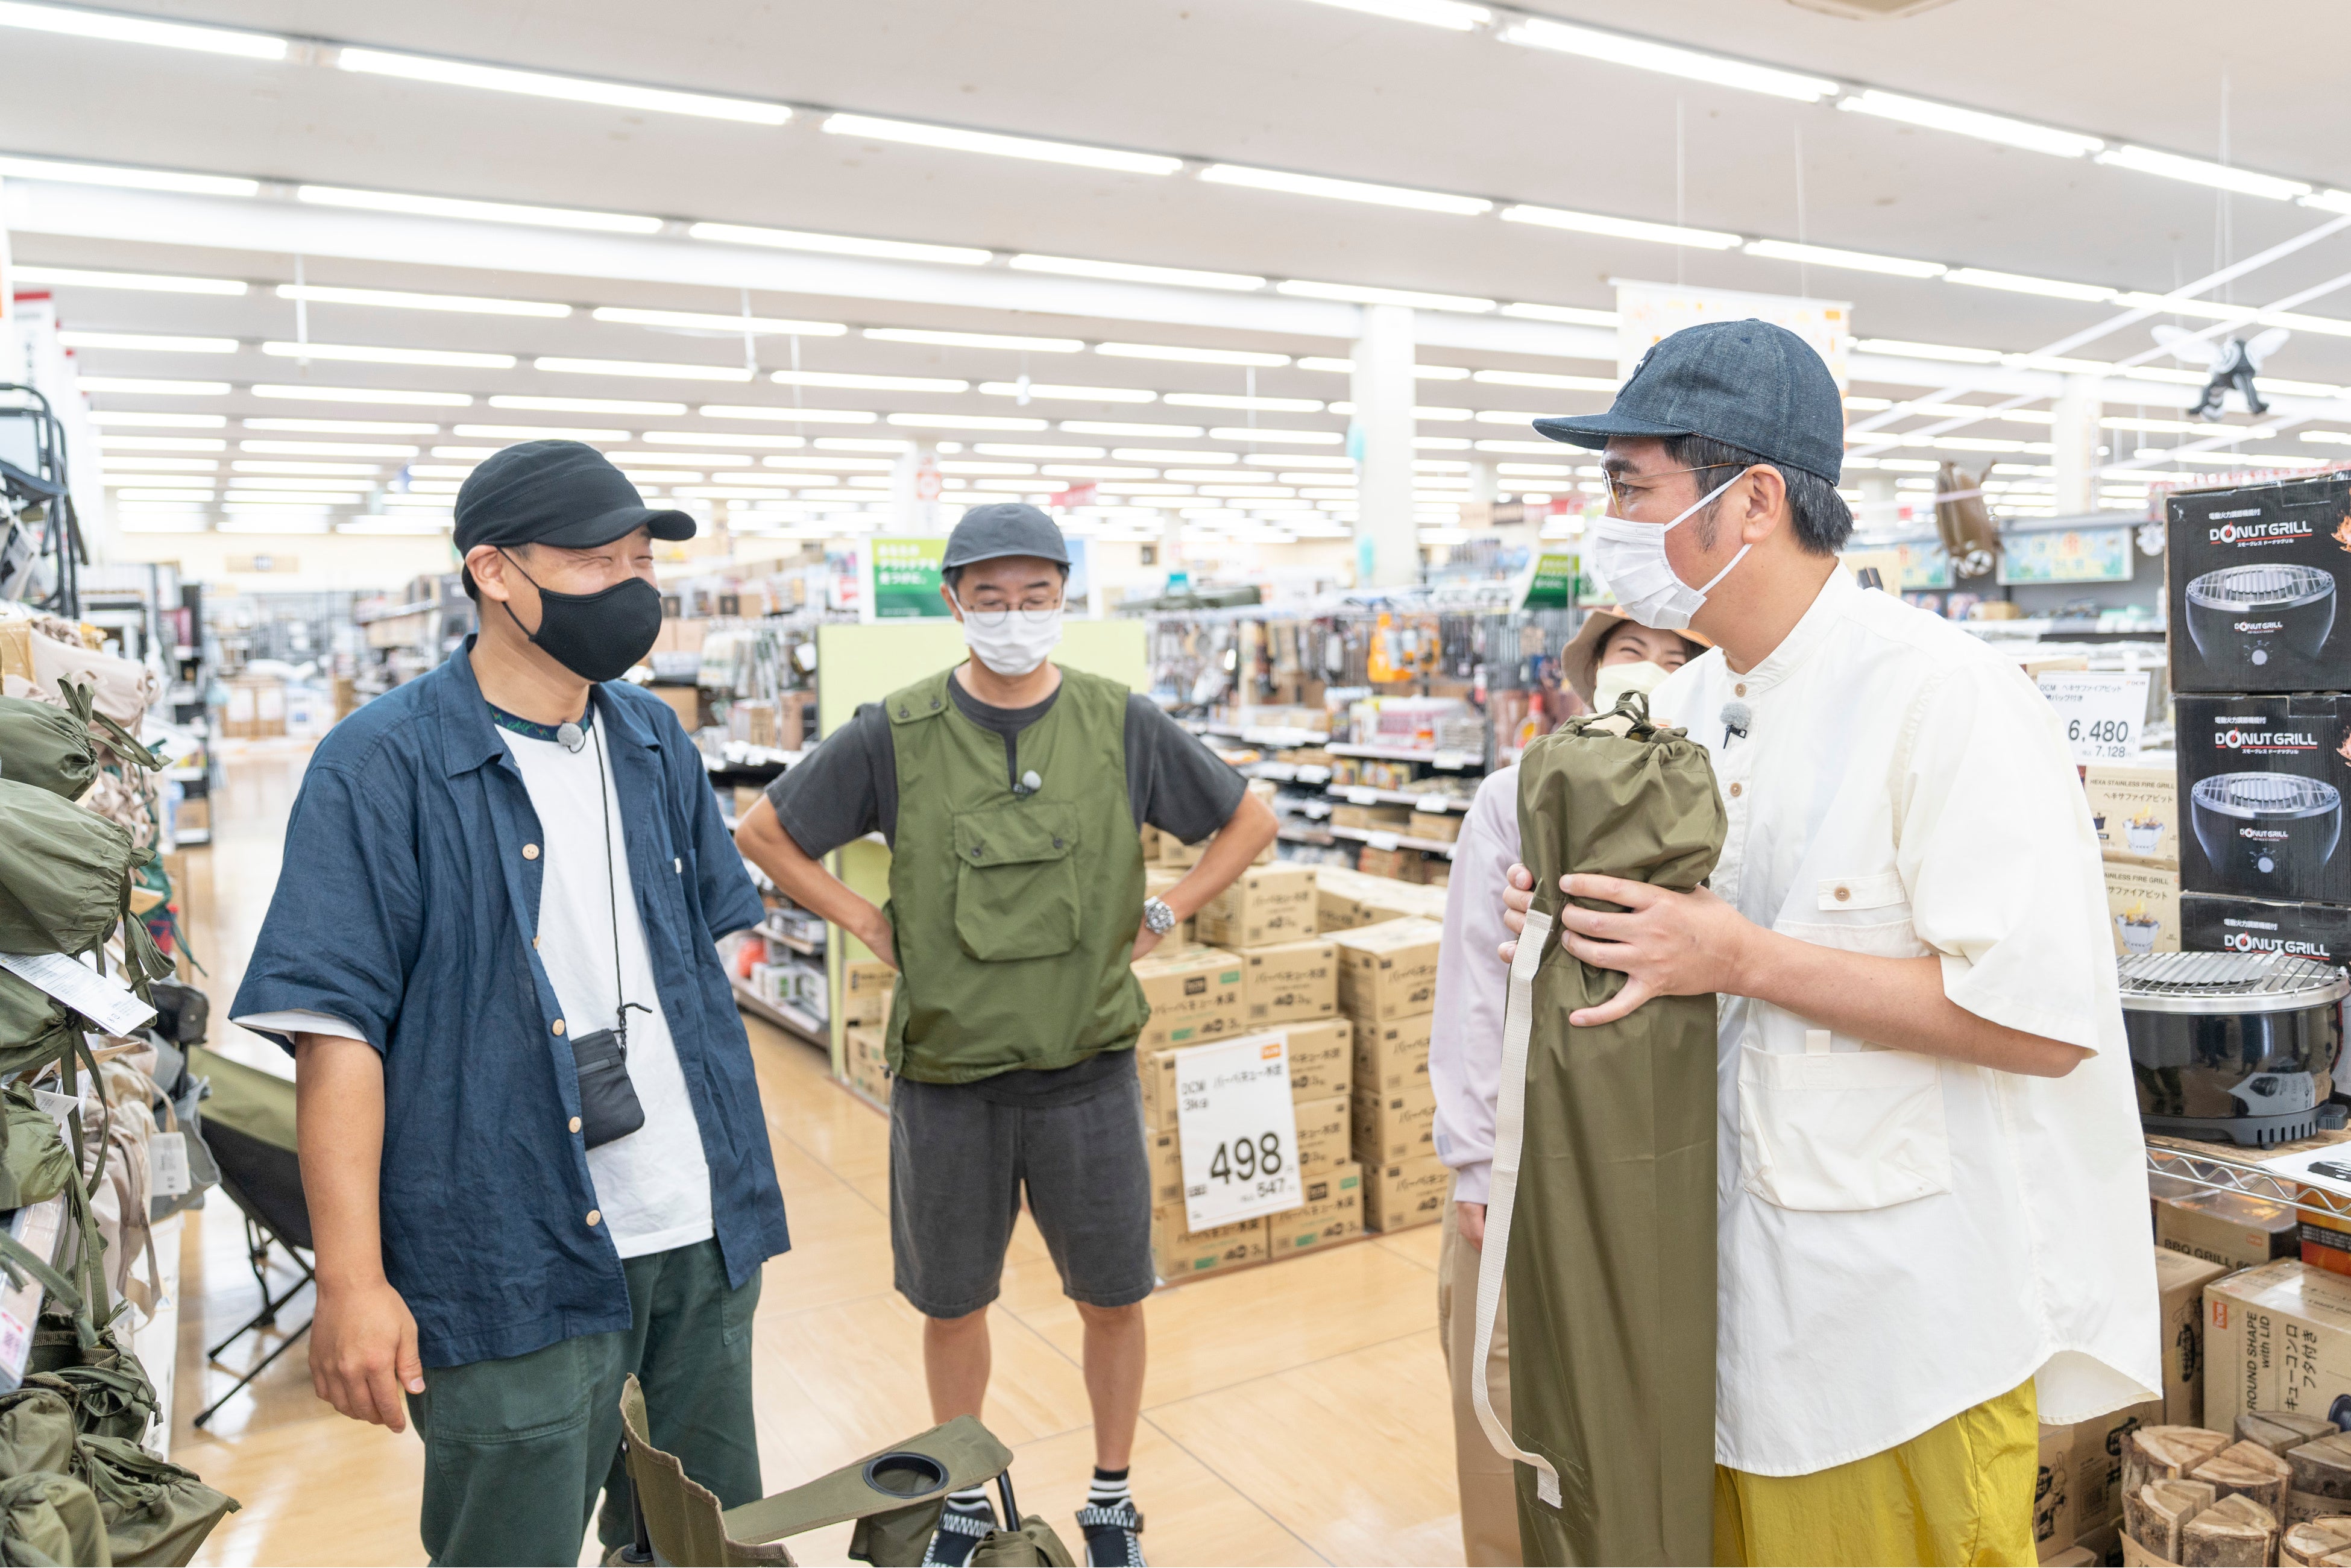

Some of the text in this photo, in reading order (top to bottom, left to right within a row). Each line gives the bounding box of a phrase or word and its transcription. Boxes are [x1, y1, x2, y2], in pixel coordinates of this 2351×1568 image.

[2209, 520, 2312, 543] DONUT GRILL
[2234, 621, 2283, 632] DONUT GRILL
[2068, 720, 2129, 743] 6,480
[2215, 729, 2318, 749] DONUT GRILL
[2239, 828, 2267, 838] DONUT
[2149, 877, 2170, 885] GRILL
[2106, 886, 2168, 900] サファイアピット
[2224, 933, 2331, 957] DONUT GRILL
[1182, 1081, 1206, 1095] DCM
[1209, 1132, 1282, 1185] 498
[1256, 1177, 1285, 1197] 547
[2164, 1239, 2190, 1255] BBQ
[2194, 1247, 2231, 1267] GRILL
[2259, 1315, 2270, 1368] with LID
[2247, 1311, 2257, 1411] ROUND SHAPE
[2302, 1330, 2317, 1389] フタ付き
